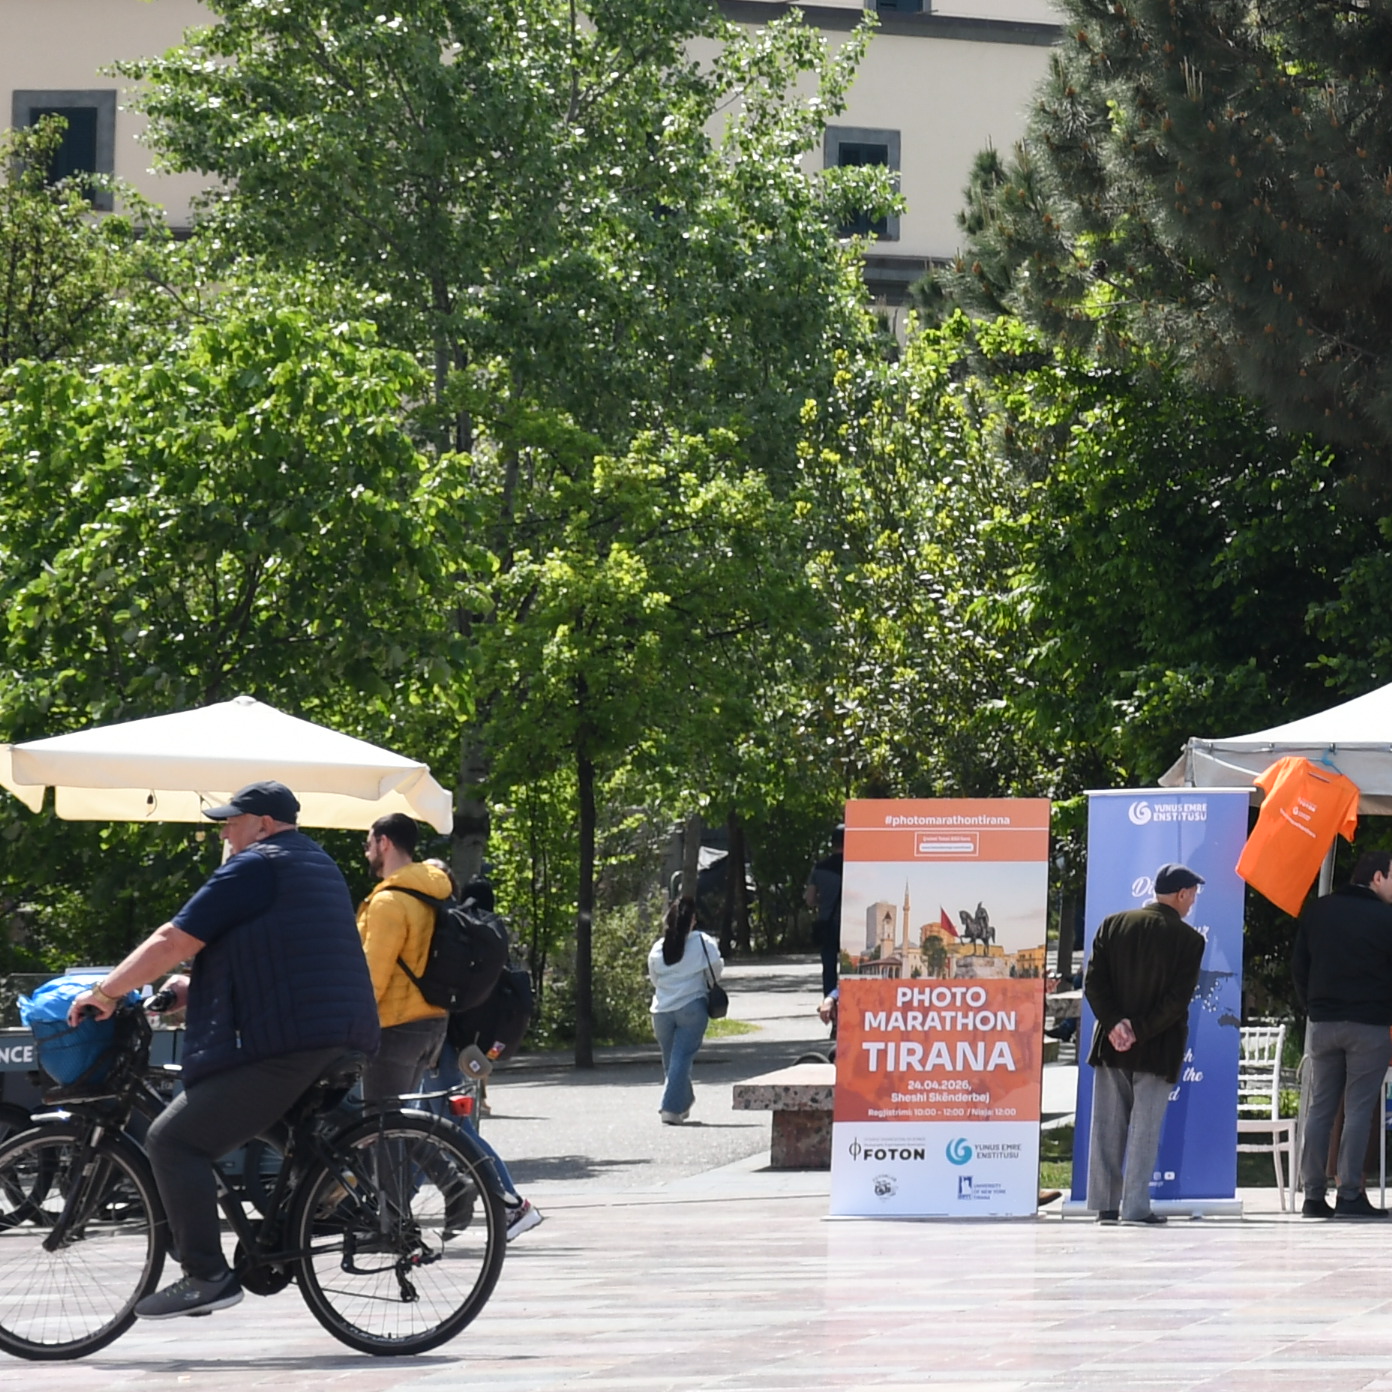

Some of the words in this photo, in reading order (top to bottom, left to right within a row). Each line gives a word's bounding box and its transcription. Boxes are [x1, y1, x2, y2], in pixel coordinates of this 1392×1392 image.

[1154, 804, 1182, 812] YUNUS
[1184, 803, 1207, 812] EMRE
[885, 815, 1010, 827] #photomarathontirana
[896, 986, 987, 1008] PHOTO
[864, 1010, 1016, 1032] MARATHON
[862, 1041, 1016, 1072] TIRANA
[1182, 1067, 1204, 1082] the
[891, 1092, 927, 1102] Sheshi
[929, 1092, 990, 1104] Skënderbej
[863, 1149, 926, 1161] FOTON
